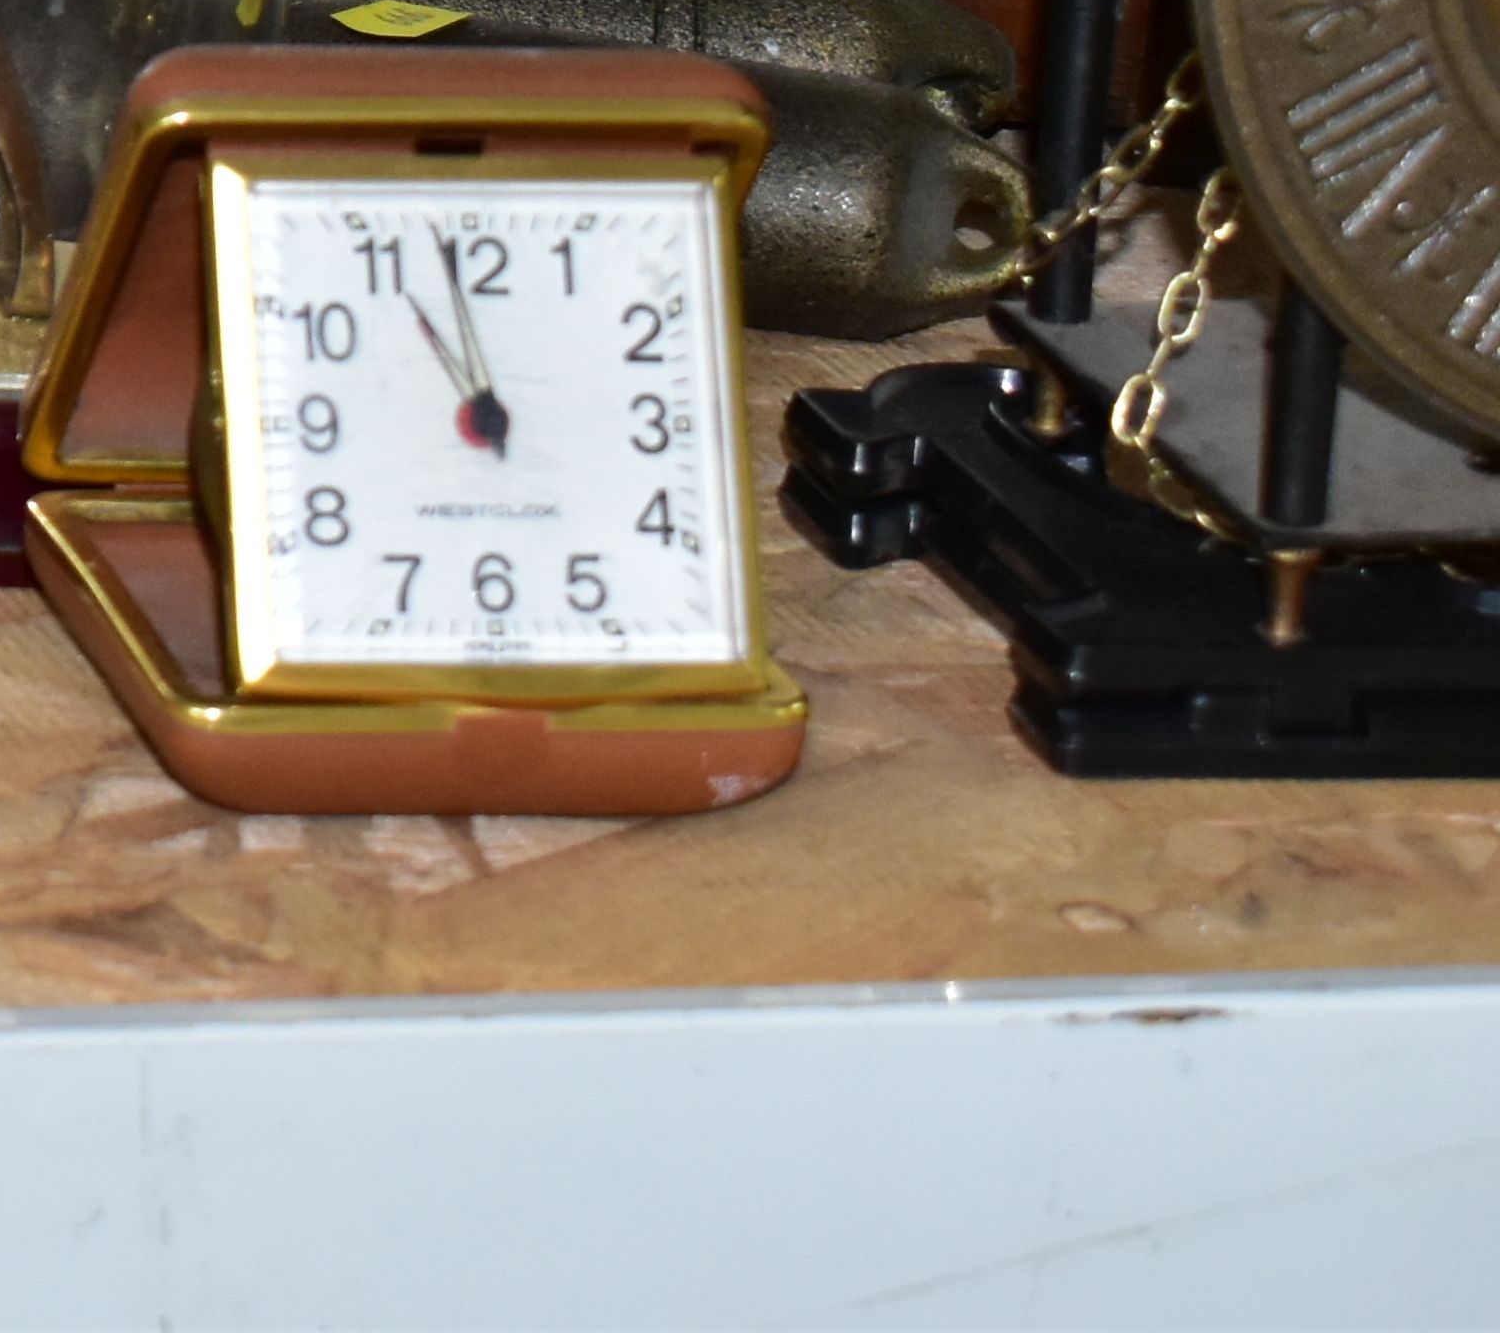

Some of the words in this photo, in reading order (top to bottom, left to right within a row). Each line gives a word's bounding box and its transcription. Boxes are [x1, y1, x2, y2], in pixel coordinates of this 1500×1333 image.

[354, 237, 402, 295] 11
[552, 239, 576, 295] 1
[297, 302, 357, 362] 10
[622, 304, 664, 363] 2
[299, 394, 340, 454] 9
[630, 395, 669, 454] 3
[303, 486, 350, 546] 8
[413, 503, 562, 519] WESTCLOX
[635, 488, 675, 546] 4
[382, 553, 422, 613] 7
[472, 552, 516, 613] 6
[566, 553, 607, 613] 5
